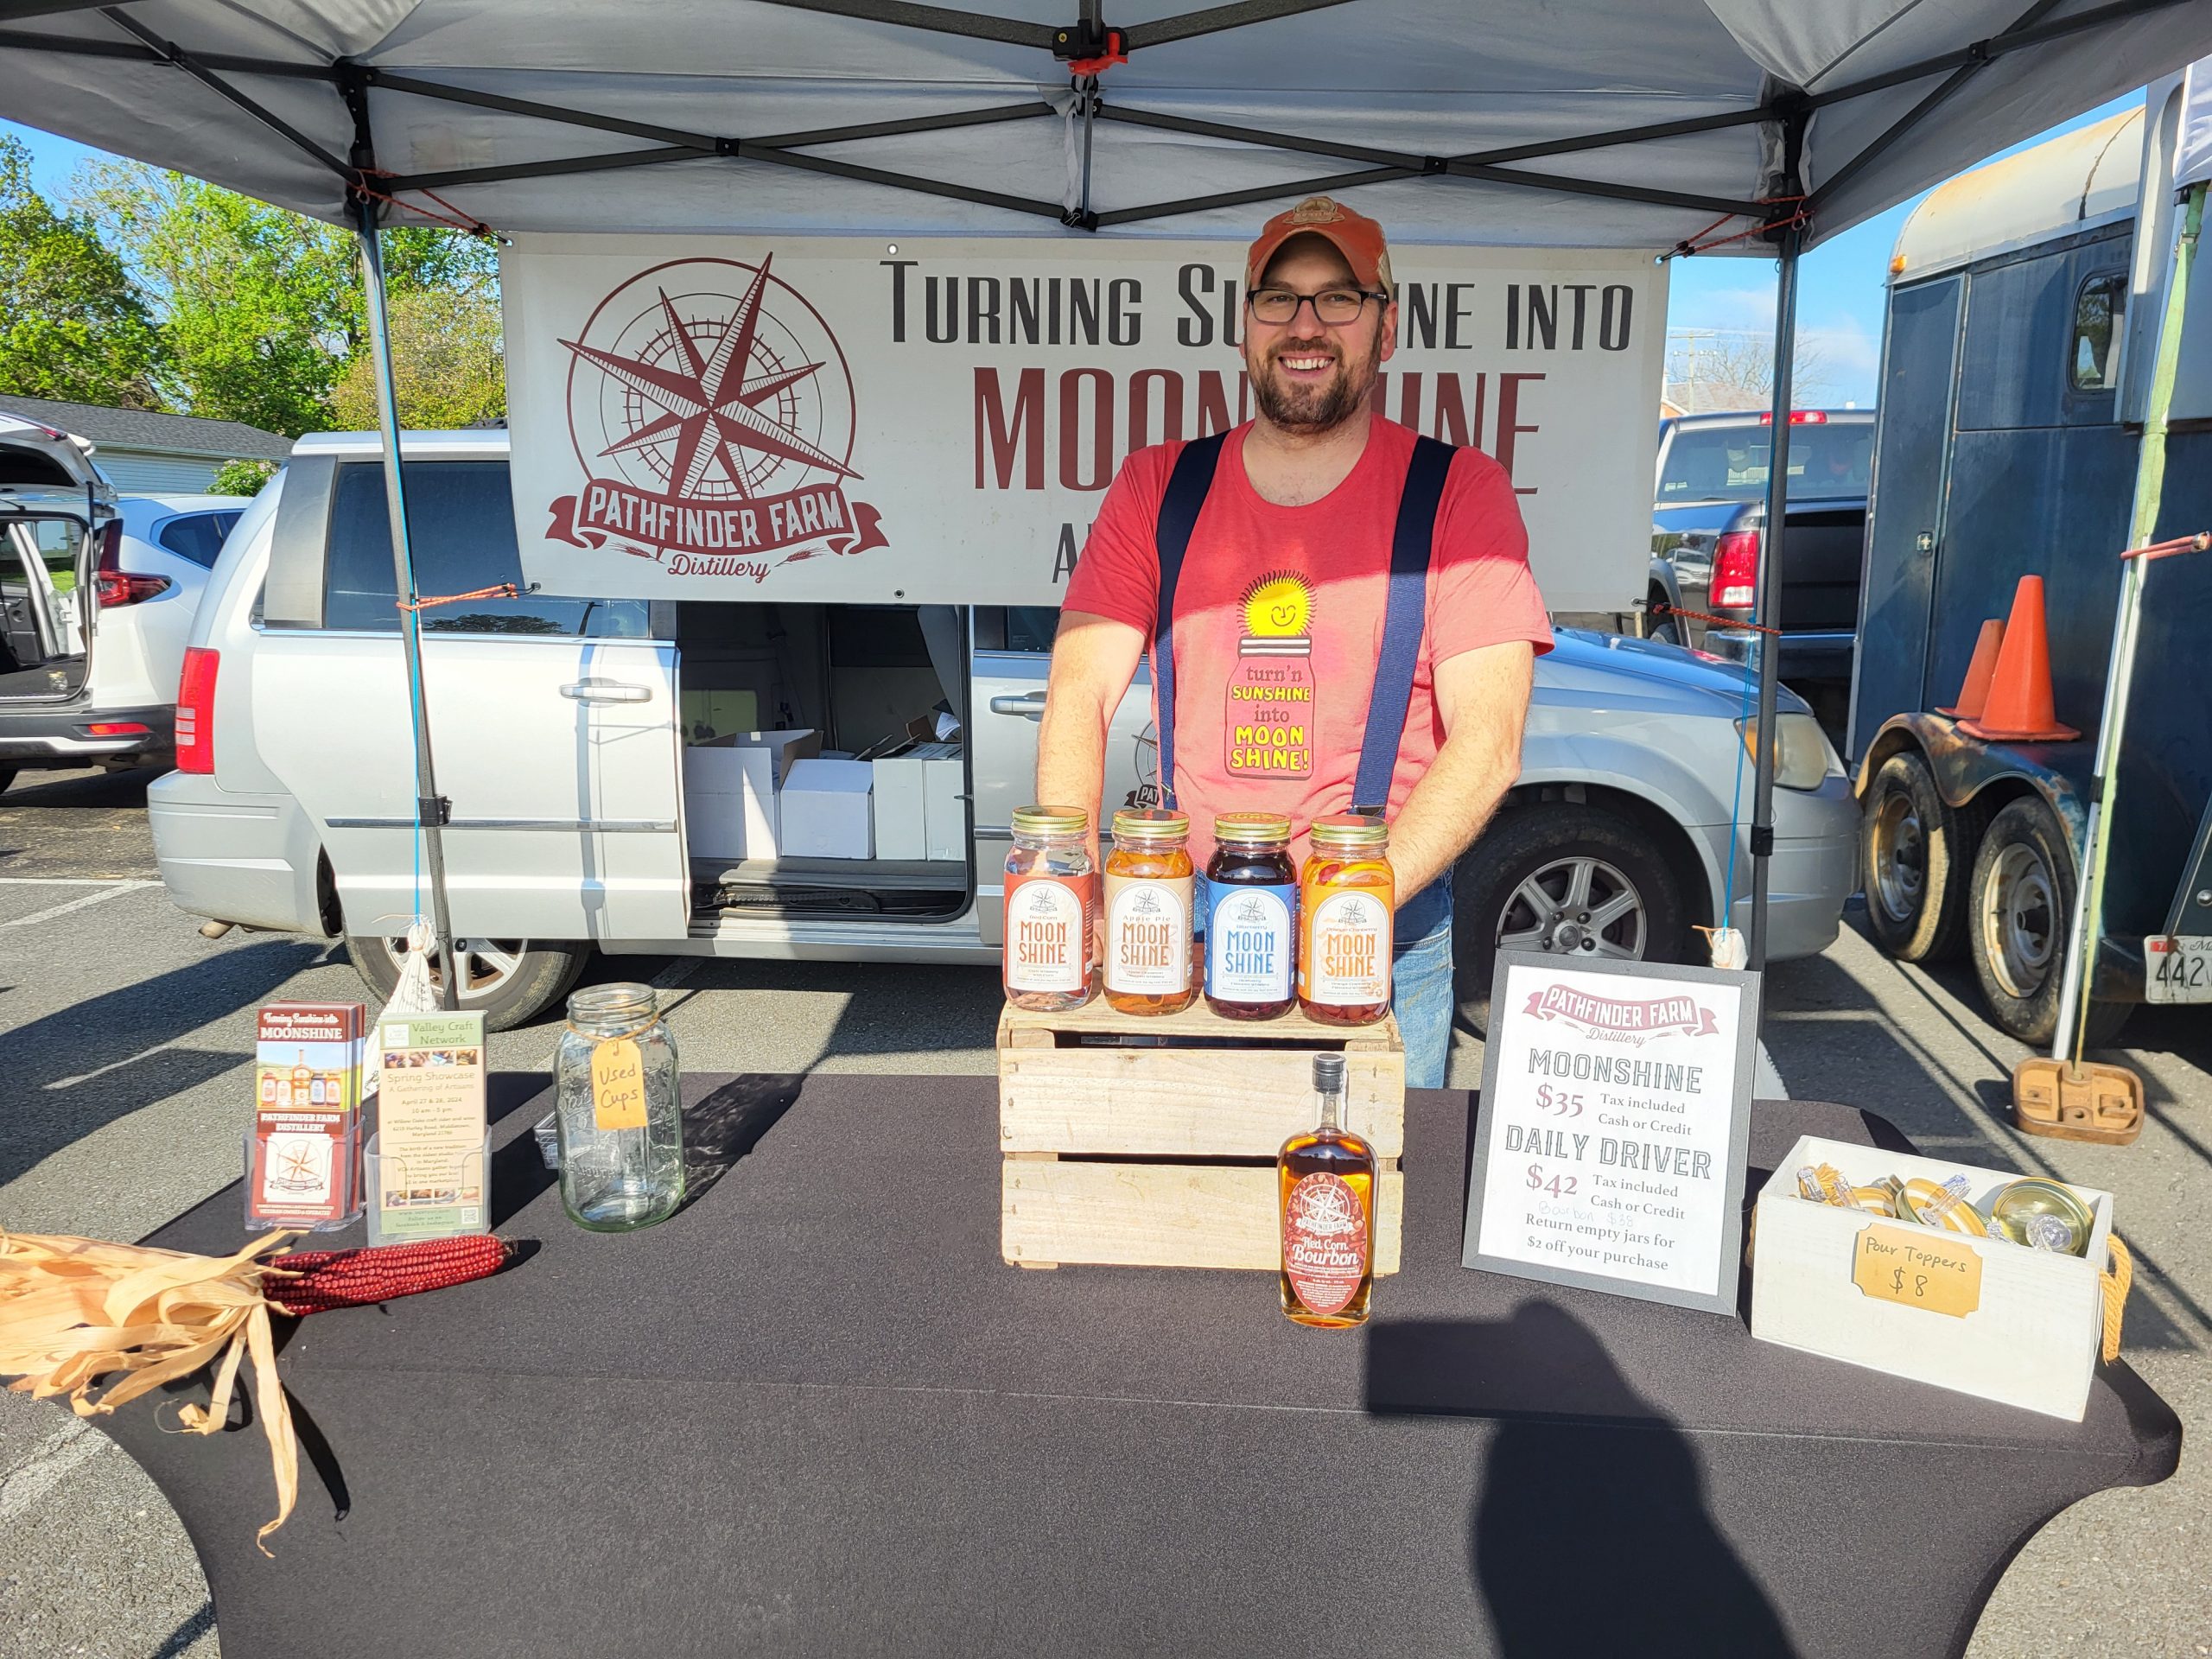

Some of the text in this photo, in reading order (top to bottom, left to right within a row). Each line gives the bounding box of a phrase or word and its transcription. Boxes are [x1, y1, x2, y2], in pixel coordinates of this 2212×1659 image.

[880, 261, 1141, 346] TURNING
[1506, 284, 1633, 351] INTO
[588, 486, 844, 548] PATHFINDER FARM
[667, 554, 771, 583] Distillery
[1246, 665, 1303, 682] turn'n
[1232, 685, 1311, 702] SUNSHINE
[1254, 704, 1290, 722] into
[1235, 725, 1305, 747] MOON
[1230, 748, 1309, 771] SHINE!
[1020, 921, 1066, 942] MOON
[1122, 923, 1170, 944] MOON
[1227, 931, 1275, 952] MOON
[1020, 943, 1066, 963] SHINE
[1121, 944, 1169, 966] SHINE
[1327, 933, 1376, 955] MOON
[1225, 952, 1274, 974] SHINE
[1325, 956, 1376, 976] SHINE
[2156, 957, 2212, 988] 442
[1546, 988, 1694, 1027] PATHFINDER FARM
[260, 1027, 343, 1039] MOONSHINE
[411, 1020, 474, 1034] Valley Craft
[1586, 1027, 1647, 1048] Distillery
[420, 1034, 467, 1045] Network
[387, 1071, 475, 1084] Spring Showcase
[599, 1062, 637, 1086] Used
[1528, 1047, 1703, 1094] MOONSHINE
[601, 1087, 639, 1111] Cups
[1535, 1082, 1584, 1118] $35
[1599, 1093, 1685, 1114] Tax included
[1599, 1113, 1693, 1135] Cash or Credit
[1505, 1124, 1712, 1180] DAILY DRIVER
[1526, 1162, 1578, 1199] $42
[1592, 1174, 1679, 1198] Tax included
[1591, 1194, 1686, 1220] Cash or Credit
[1526, 1212, 1675, 1249] Return empty jars for
[1293, 1243, 1359, 1266] Bourbon
[1301, 1236, 1349, 1251] Red Corn
[1527, 1236, 1669, 1271] $2 off your purchase
[1866, 1236, 1967, 1273] Pour Toppers
